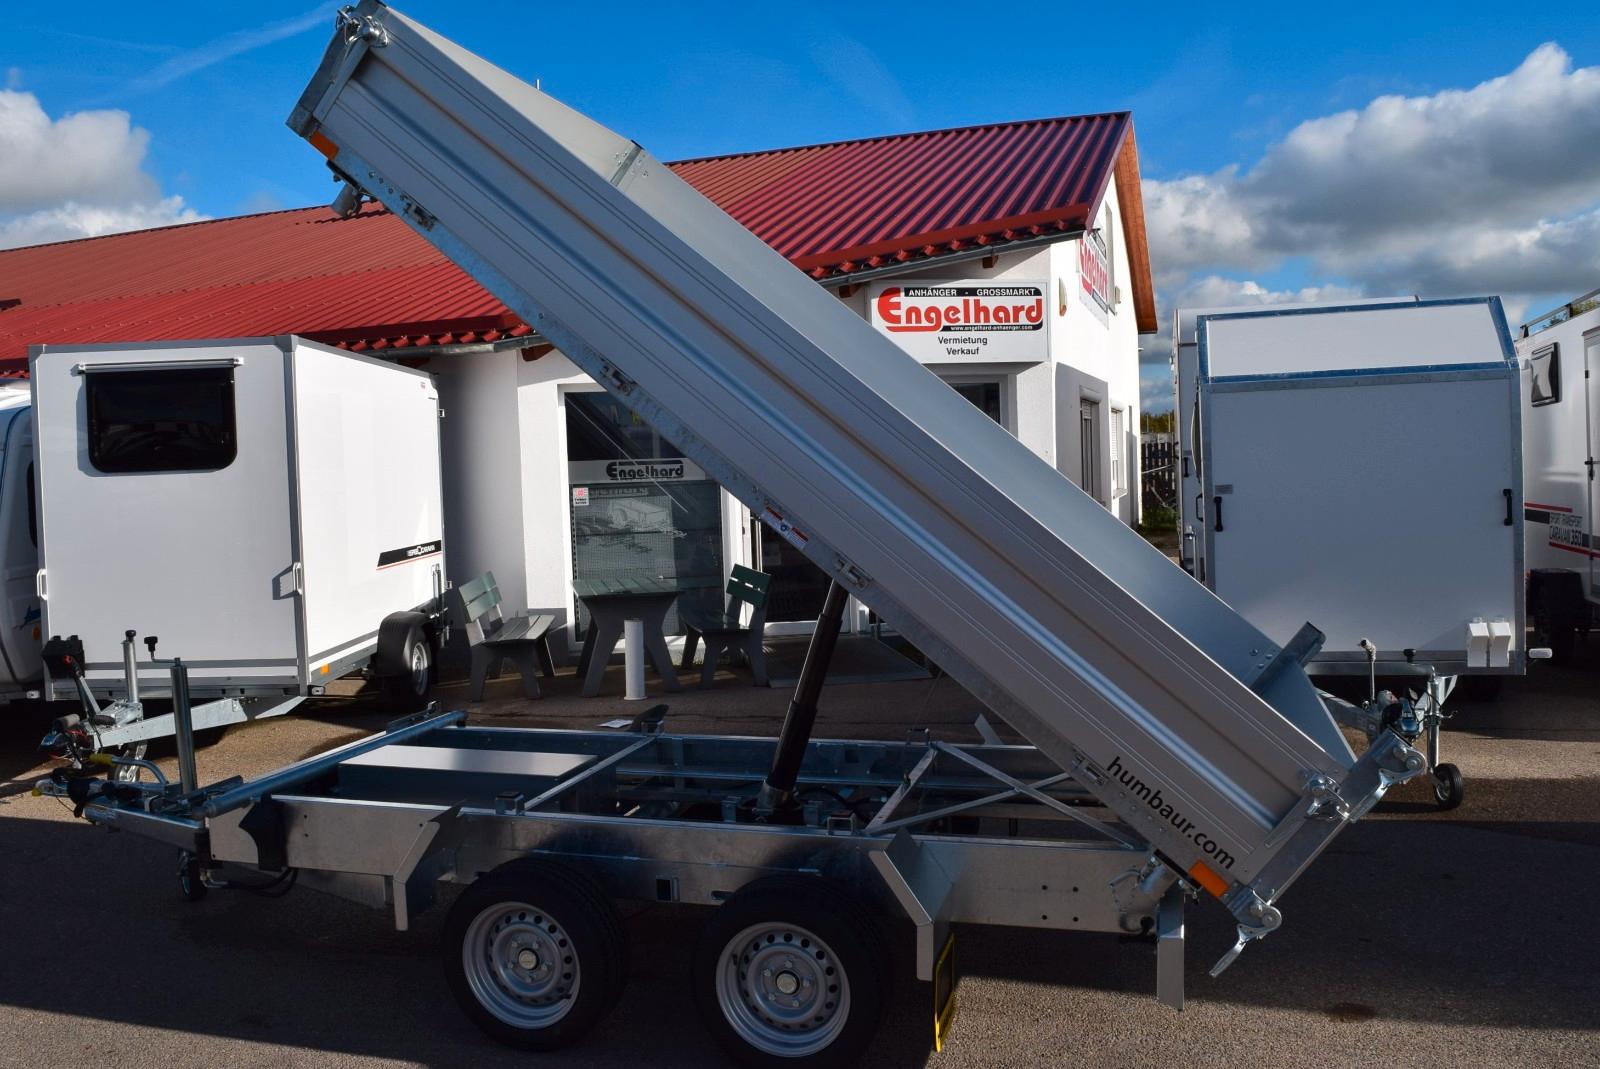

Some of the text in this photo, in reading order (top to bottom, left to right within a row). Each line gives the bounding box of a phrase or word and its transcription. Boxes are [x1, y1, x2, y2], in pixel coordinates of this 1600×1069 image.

[908, 287, 1036, 297] ANHÄNGER GROSSMARKT
[877, 286, 1044, 333] Engelhard
[950, 324, 1033, 332] www.engelhard-anhaenger.com
[937, 336, 988, 345] Vermietung
[946, 347, 980, 356] Verkauf
[606, 461, 684, 481] Engelhard
[1549, 525, 1570, 544] CARAVAN
[1106, 756, 1236, 870] humbaur.com
